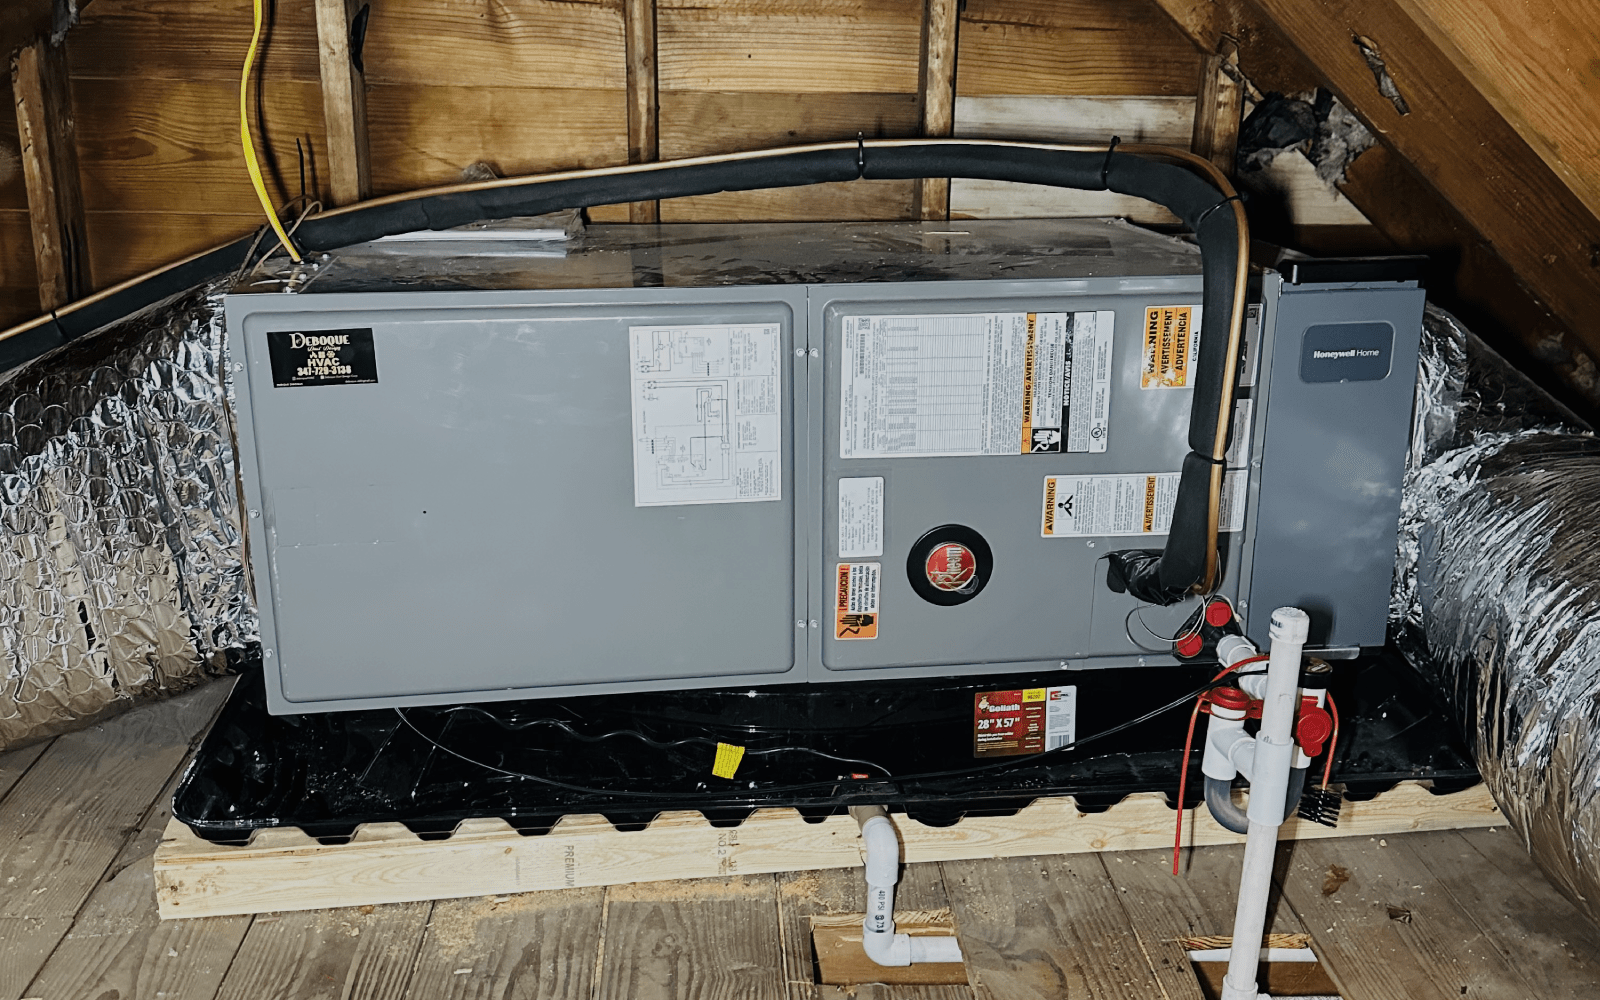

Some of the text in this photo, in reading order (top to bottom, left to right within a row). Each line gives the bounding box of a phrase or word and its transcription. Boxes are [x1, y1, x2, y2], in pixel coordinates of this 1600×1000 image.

[289, 333, 350, 349] DEBOQUE
[1175, 312, 1187, 370] ADVERTENCIA
[1313, 350, 1355, 359] Honeywell
[307, 358, 340, 366] HVAC
[1063, 361, 1071, 406] NOTICE/AVIS
[1045, 482, 1055, 523] WARNING
[1146, 477, 1155, 523] AVERTISSEMENT
[930, 547, 968, 589] Rheem
[978, 717, 1020, 729] 28" X 57"
[989, 704, 1020, 713] Goliath
[564, 845, 575, 887] PREMIUM
